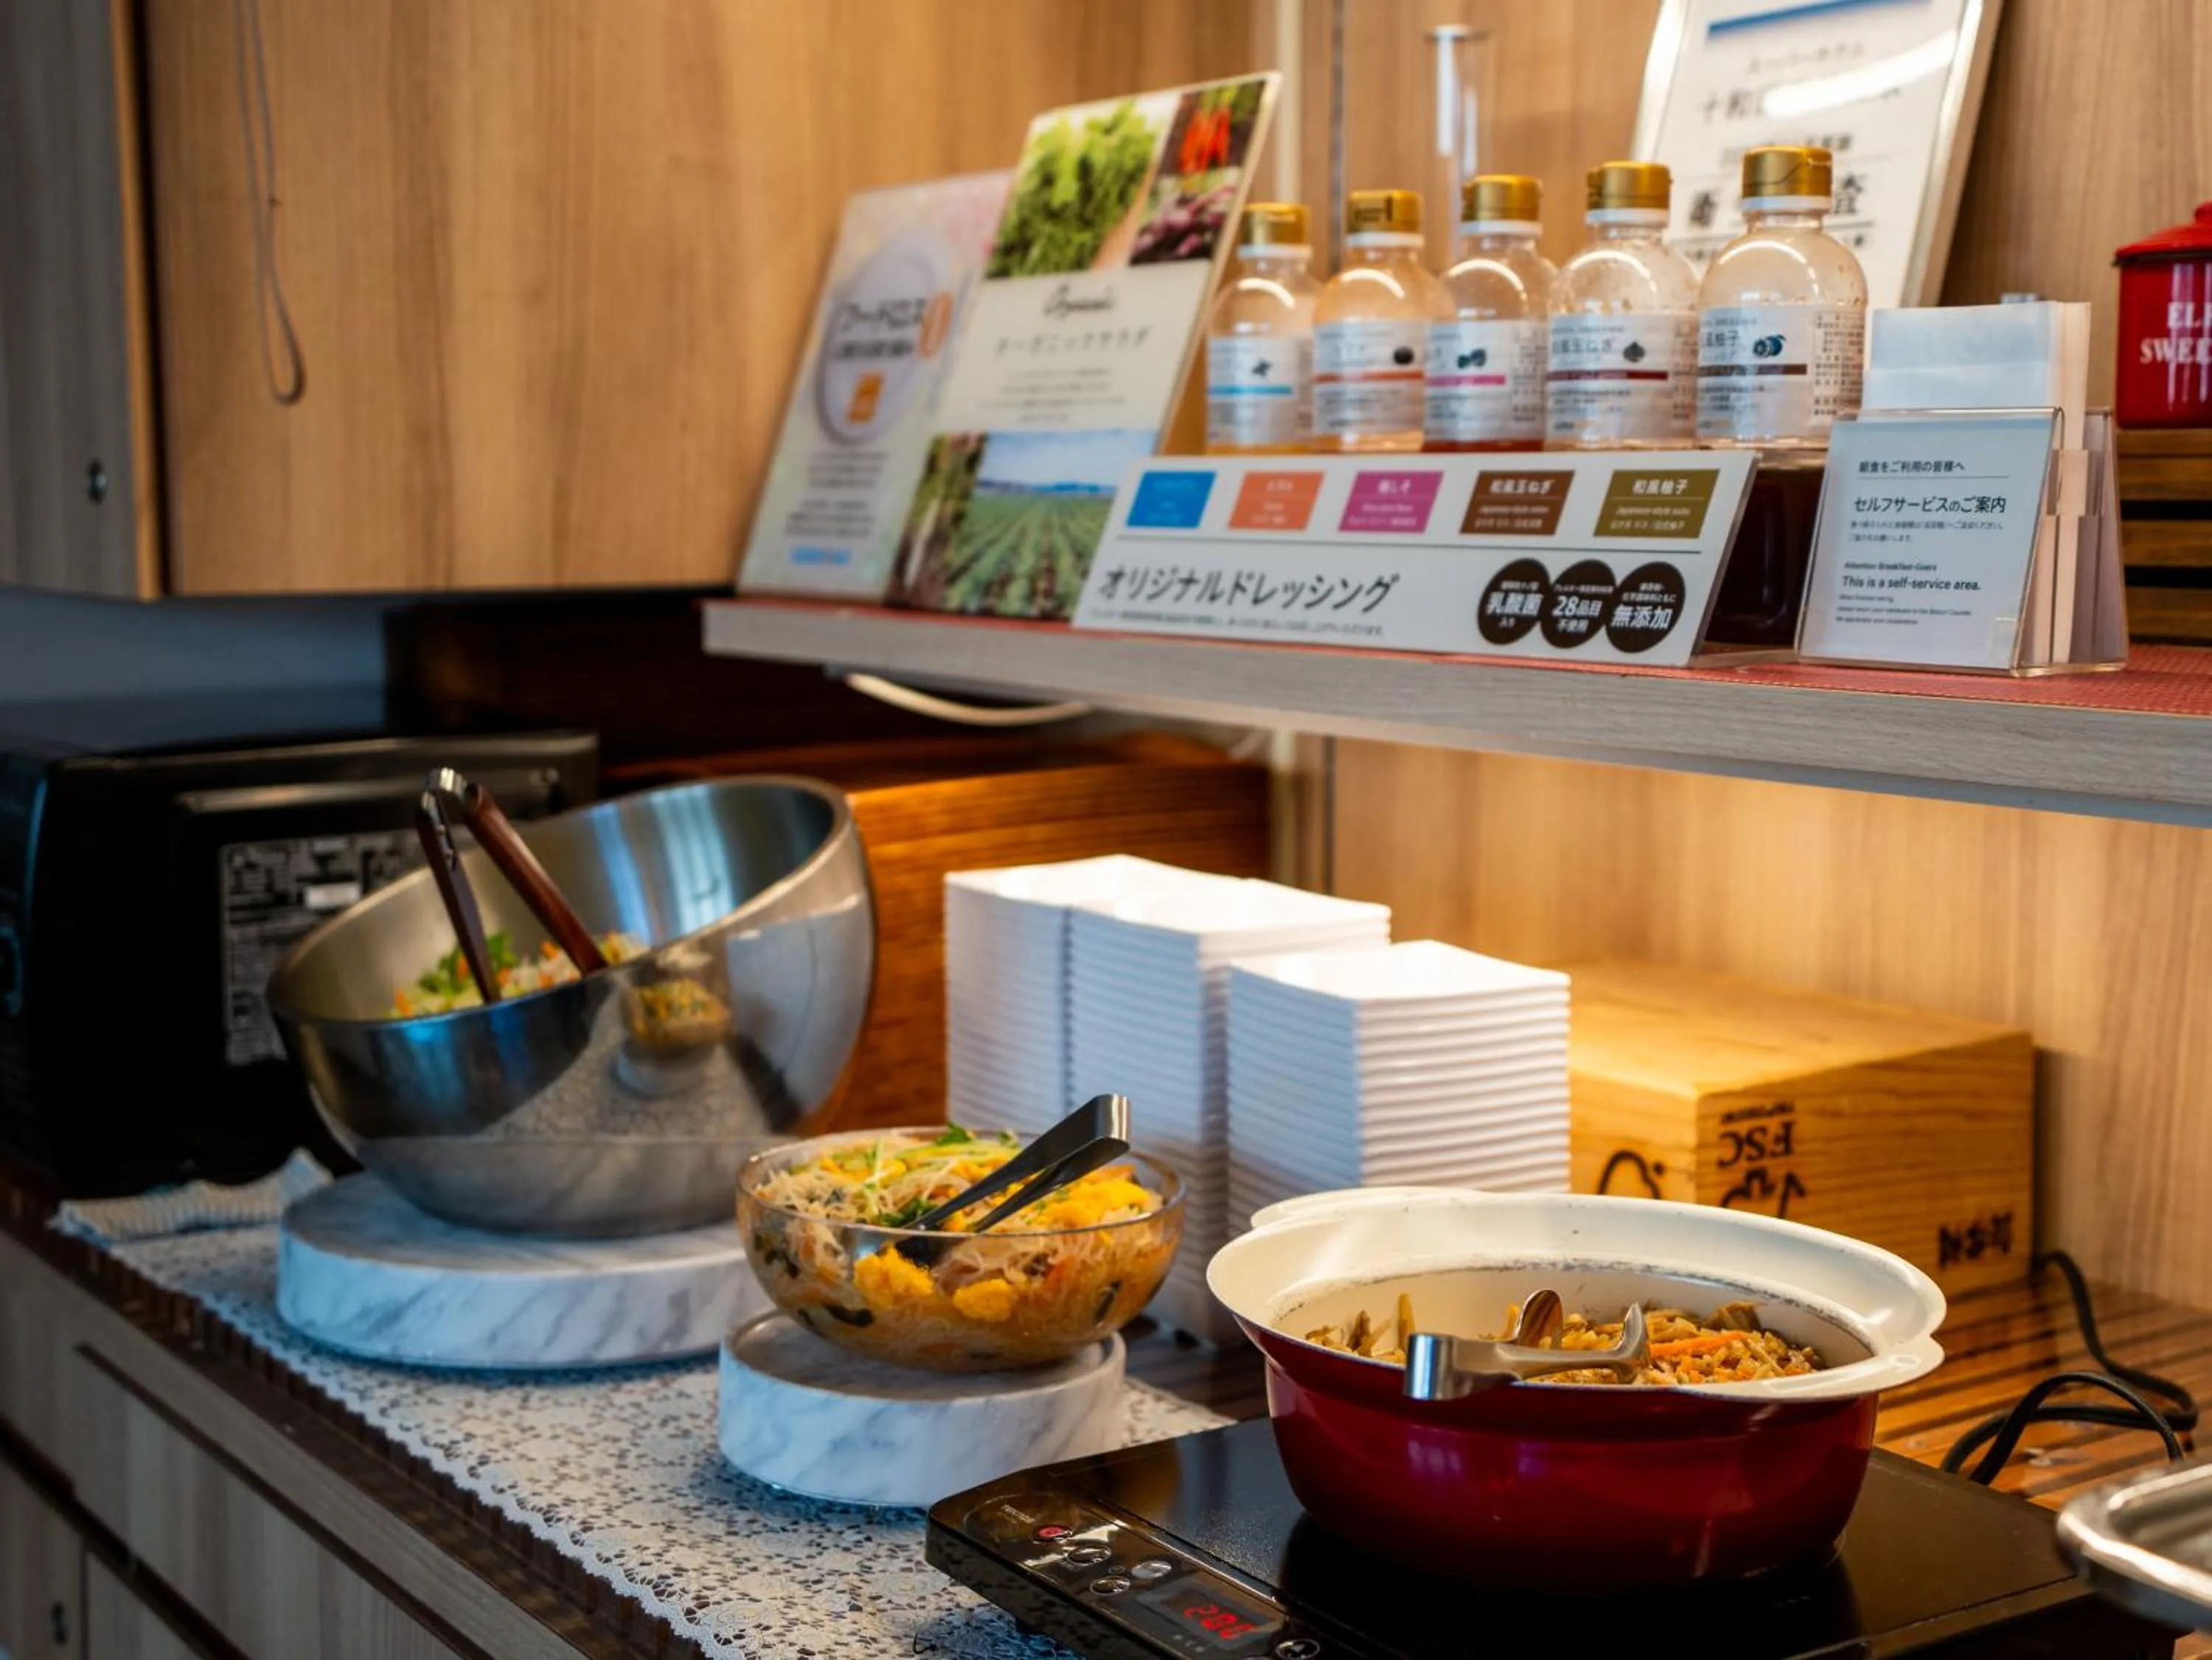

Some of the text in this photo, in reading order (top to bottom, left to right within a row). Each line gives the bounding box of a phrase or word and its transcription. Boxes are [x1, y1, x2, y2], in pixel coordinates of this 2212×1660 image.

[1632, 478, 1688, 495] 和風柚子
[1854, 495, 2007, 513] セルフサービスのご案内
[1099, 565, 1400, 613] オリジナルドレッシング
[1843, 576, 1981, 590] This is a self-service area.
[1486, 592, 1544, 615] 乳酸菌
[1551, 595, 1603, 617] 28品目
[1556, 619, 1590, 633] 不使用
[1611, 606, 1673, 629] 無添加
